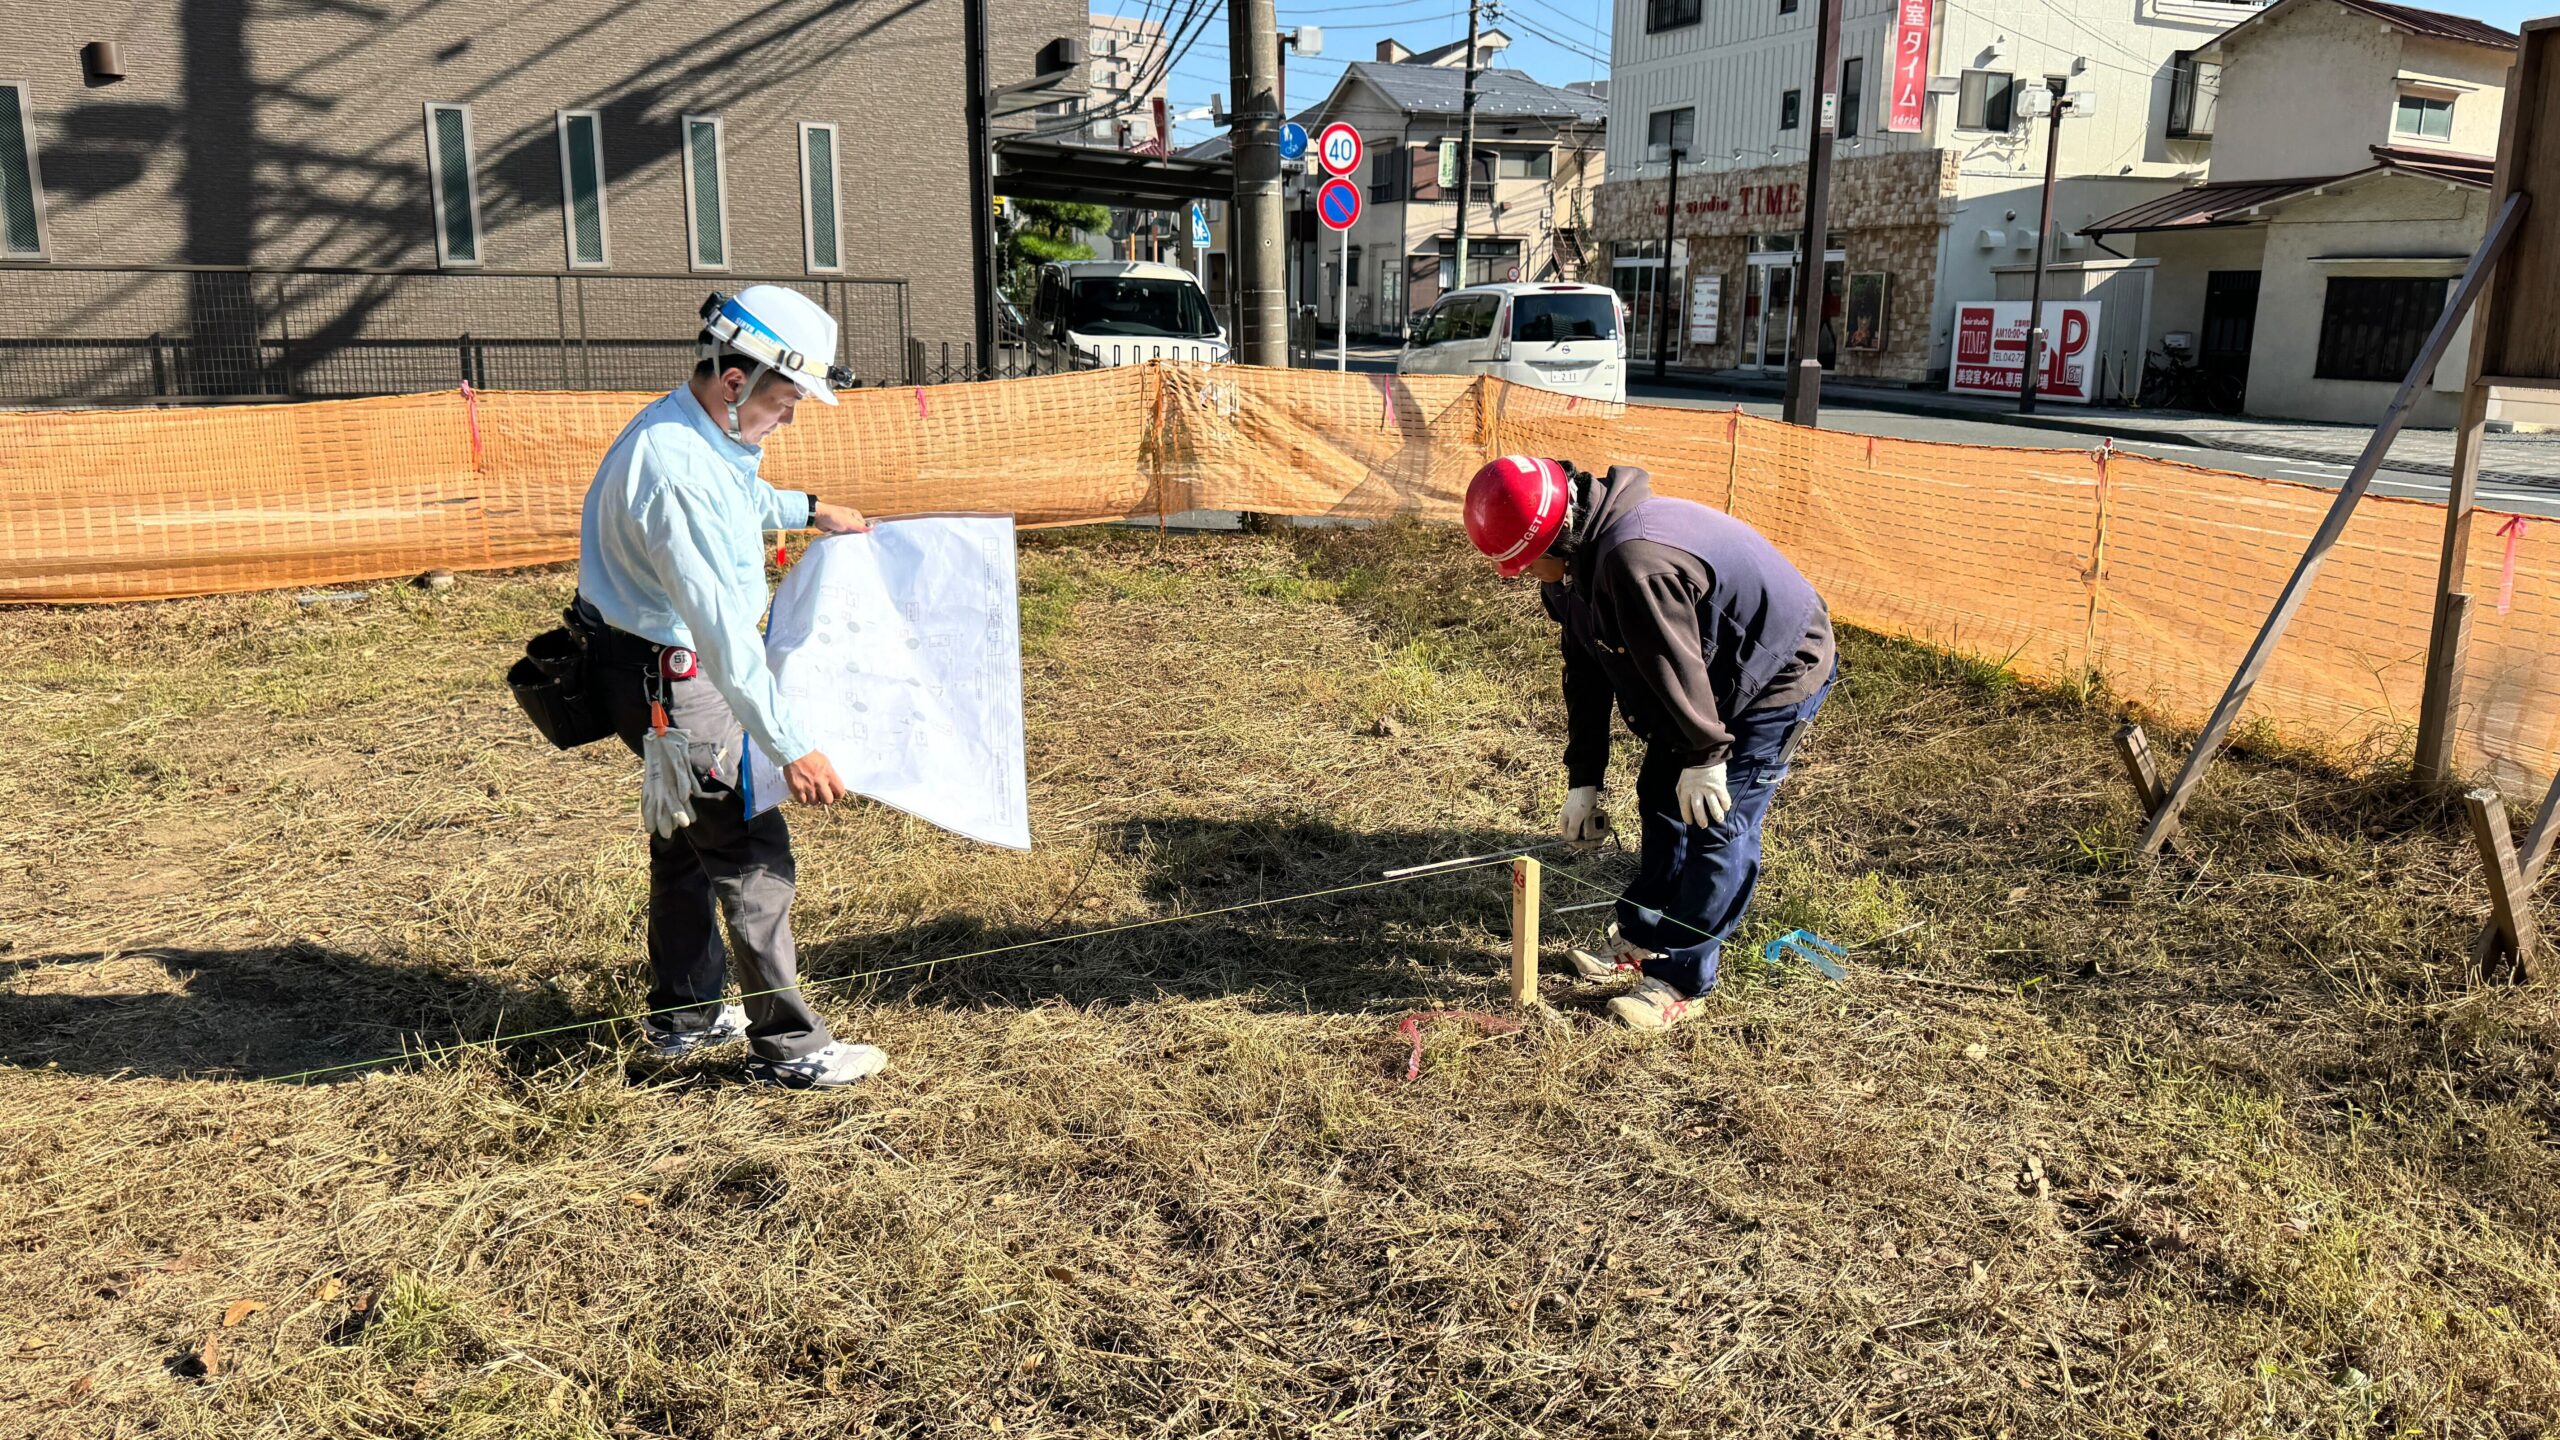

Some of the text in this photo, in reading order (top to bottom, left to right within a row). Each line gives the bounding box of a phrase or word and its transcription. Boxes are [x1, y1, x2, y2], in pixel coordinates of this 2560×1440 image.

[1899, 0, 1926, 107] 室タイム
[1329, 138, 1353, 161] 40
[1738, 183, 1802, 217] TIME
[2055, 309, 2090, 384] P
[1956, 369, 1981, 385] 美容室
[1983, 370, 2004, 387] タイム
[1523, 516, 1543, 541] GET
